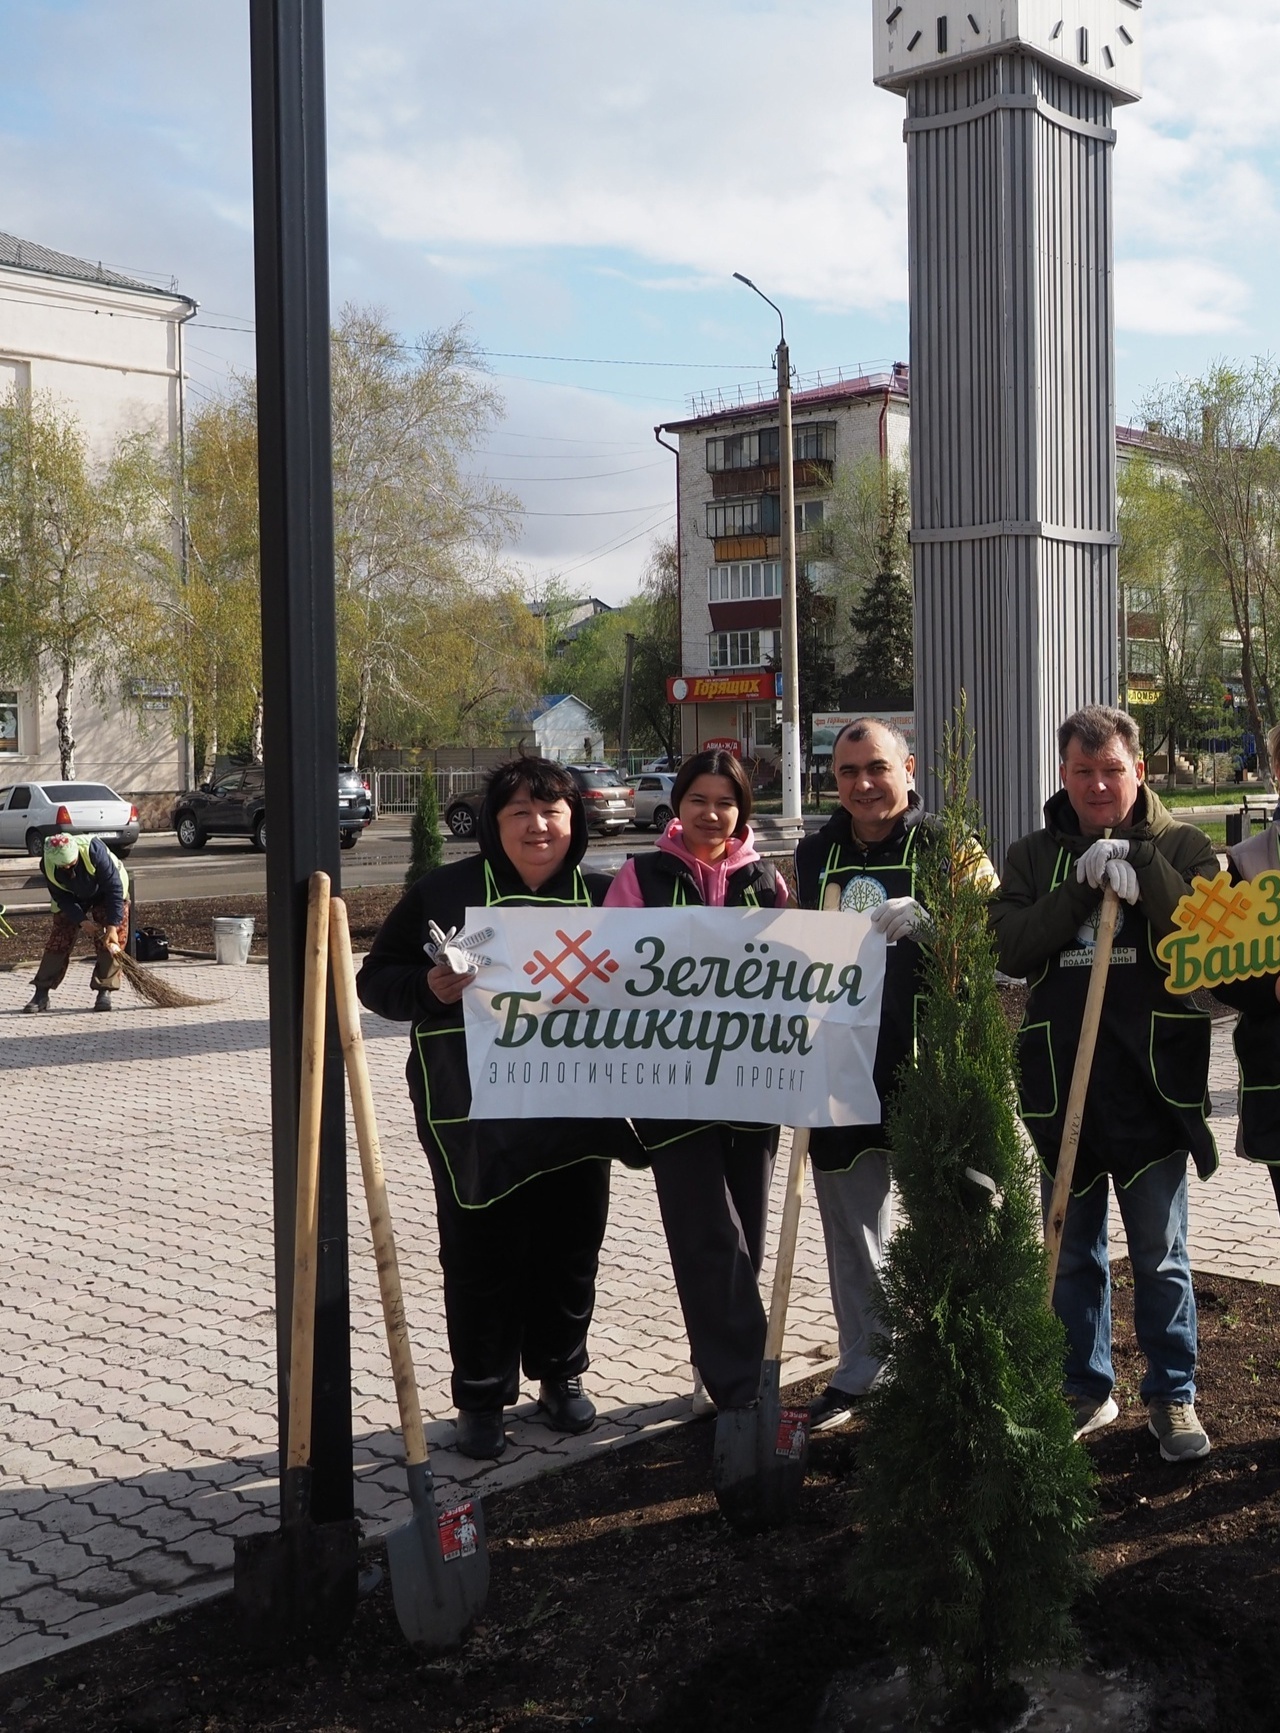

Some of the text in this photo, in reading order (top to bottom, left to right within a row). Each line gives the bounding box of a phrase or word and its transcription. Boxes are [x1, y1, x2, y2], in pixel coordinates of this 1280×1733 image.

[693, 680, 760, 699] Горящих
[1061, 949, 1093, 958] ПОСАДИ
[625, 936, 867, 1006] Зелёная
[491, 991, 813, 1085] Башкирия
[488, 1060, 805, 1092] ЭКОЛОГИЧЕСКИЙ ПРОЕКТ
[446, 1503, 471, 1517] ЗУБР
